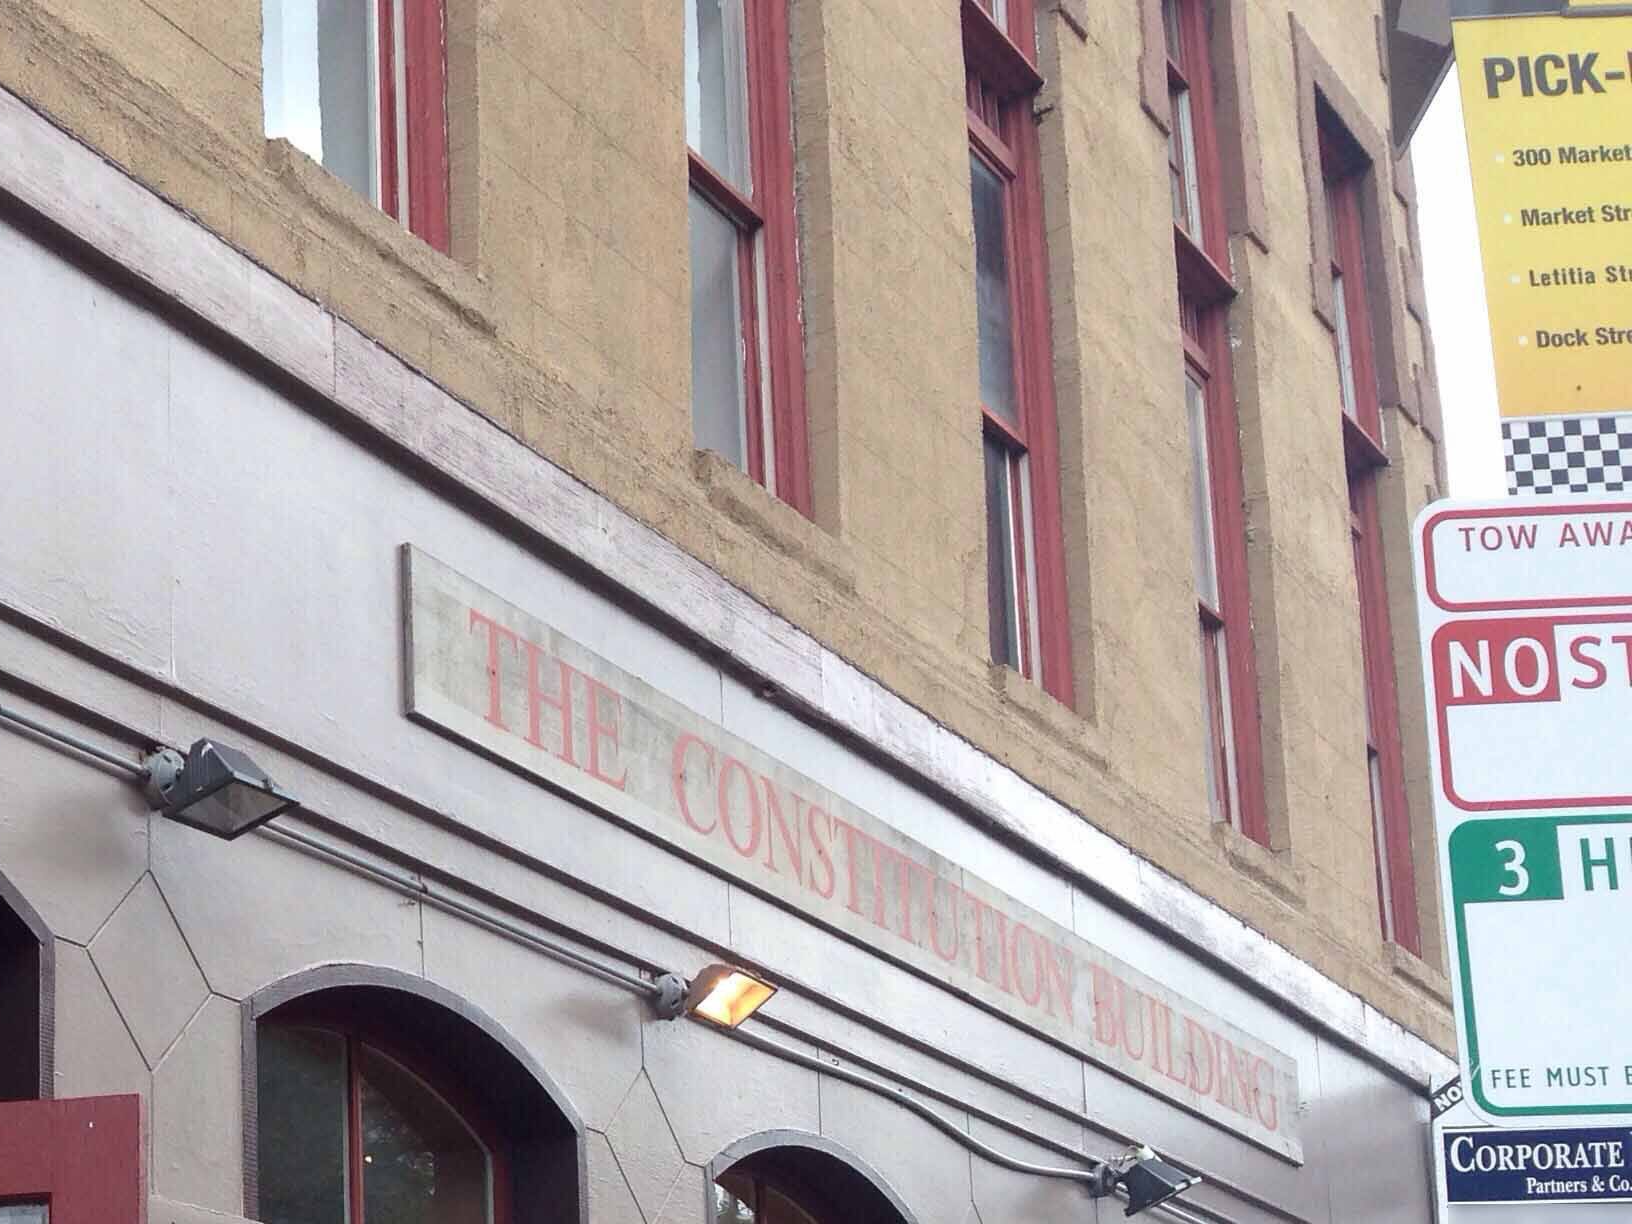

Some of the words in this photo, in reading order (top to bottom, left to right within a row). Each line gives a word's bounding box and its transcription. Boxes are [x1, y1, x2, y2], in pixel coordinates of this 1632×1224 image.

[1483, 51, 1632, 99] PICK-
[1512, 147, 1551, 167] 300
[1559, 144, 1632, 165] Market
[1521, 207, 1594, 227] Market
[1600, 204, 1632, 223] Str
[1529, 267, 1596, 287] Letitia
[1536, 328, 1589, 348] Dock
[1459, 524, 1538, 552] TOW
[1448, 636, 1550, 698] NO
[469, 607, 629, 791] THE
[672, 732, 1075, 1025] CONSTITUTION
[1088, 960, 1279, 1132] BUILDING
[1494, 839, 1529, 896] 3
[1579, 836, 1632, 892] H
[1491, 1068, 1531, 1089] FEE
[1546, 1065, 1609, 1087] MUST
[1434, 1082, 1463, 1112] NO
[1450, 1135, 1625, 1172] CORPORATE
[1526, 1176, 1588, 1195] Partners
[1591, 1175, 1605, 1193] &
[1609, 1174, 1632, 1192] Co.
